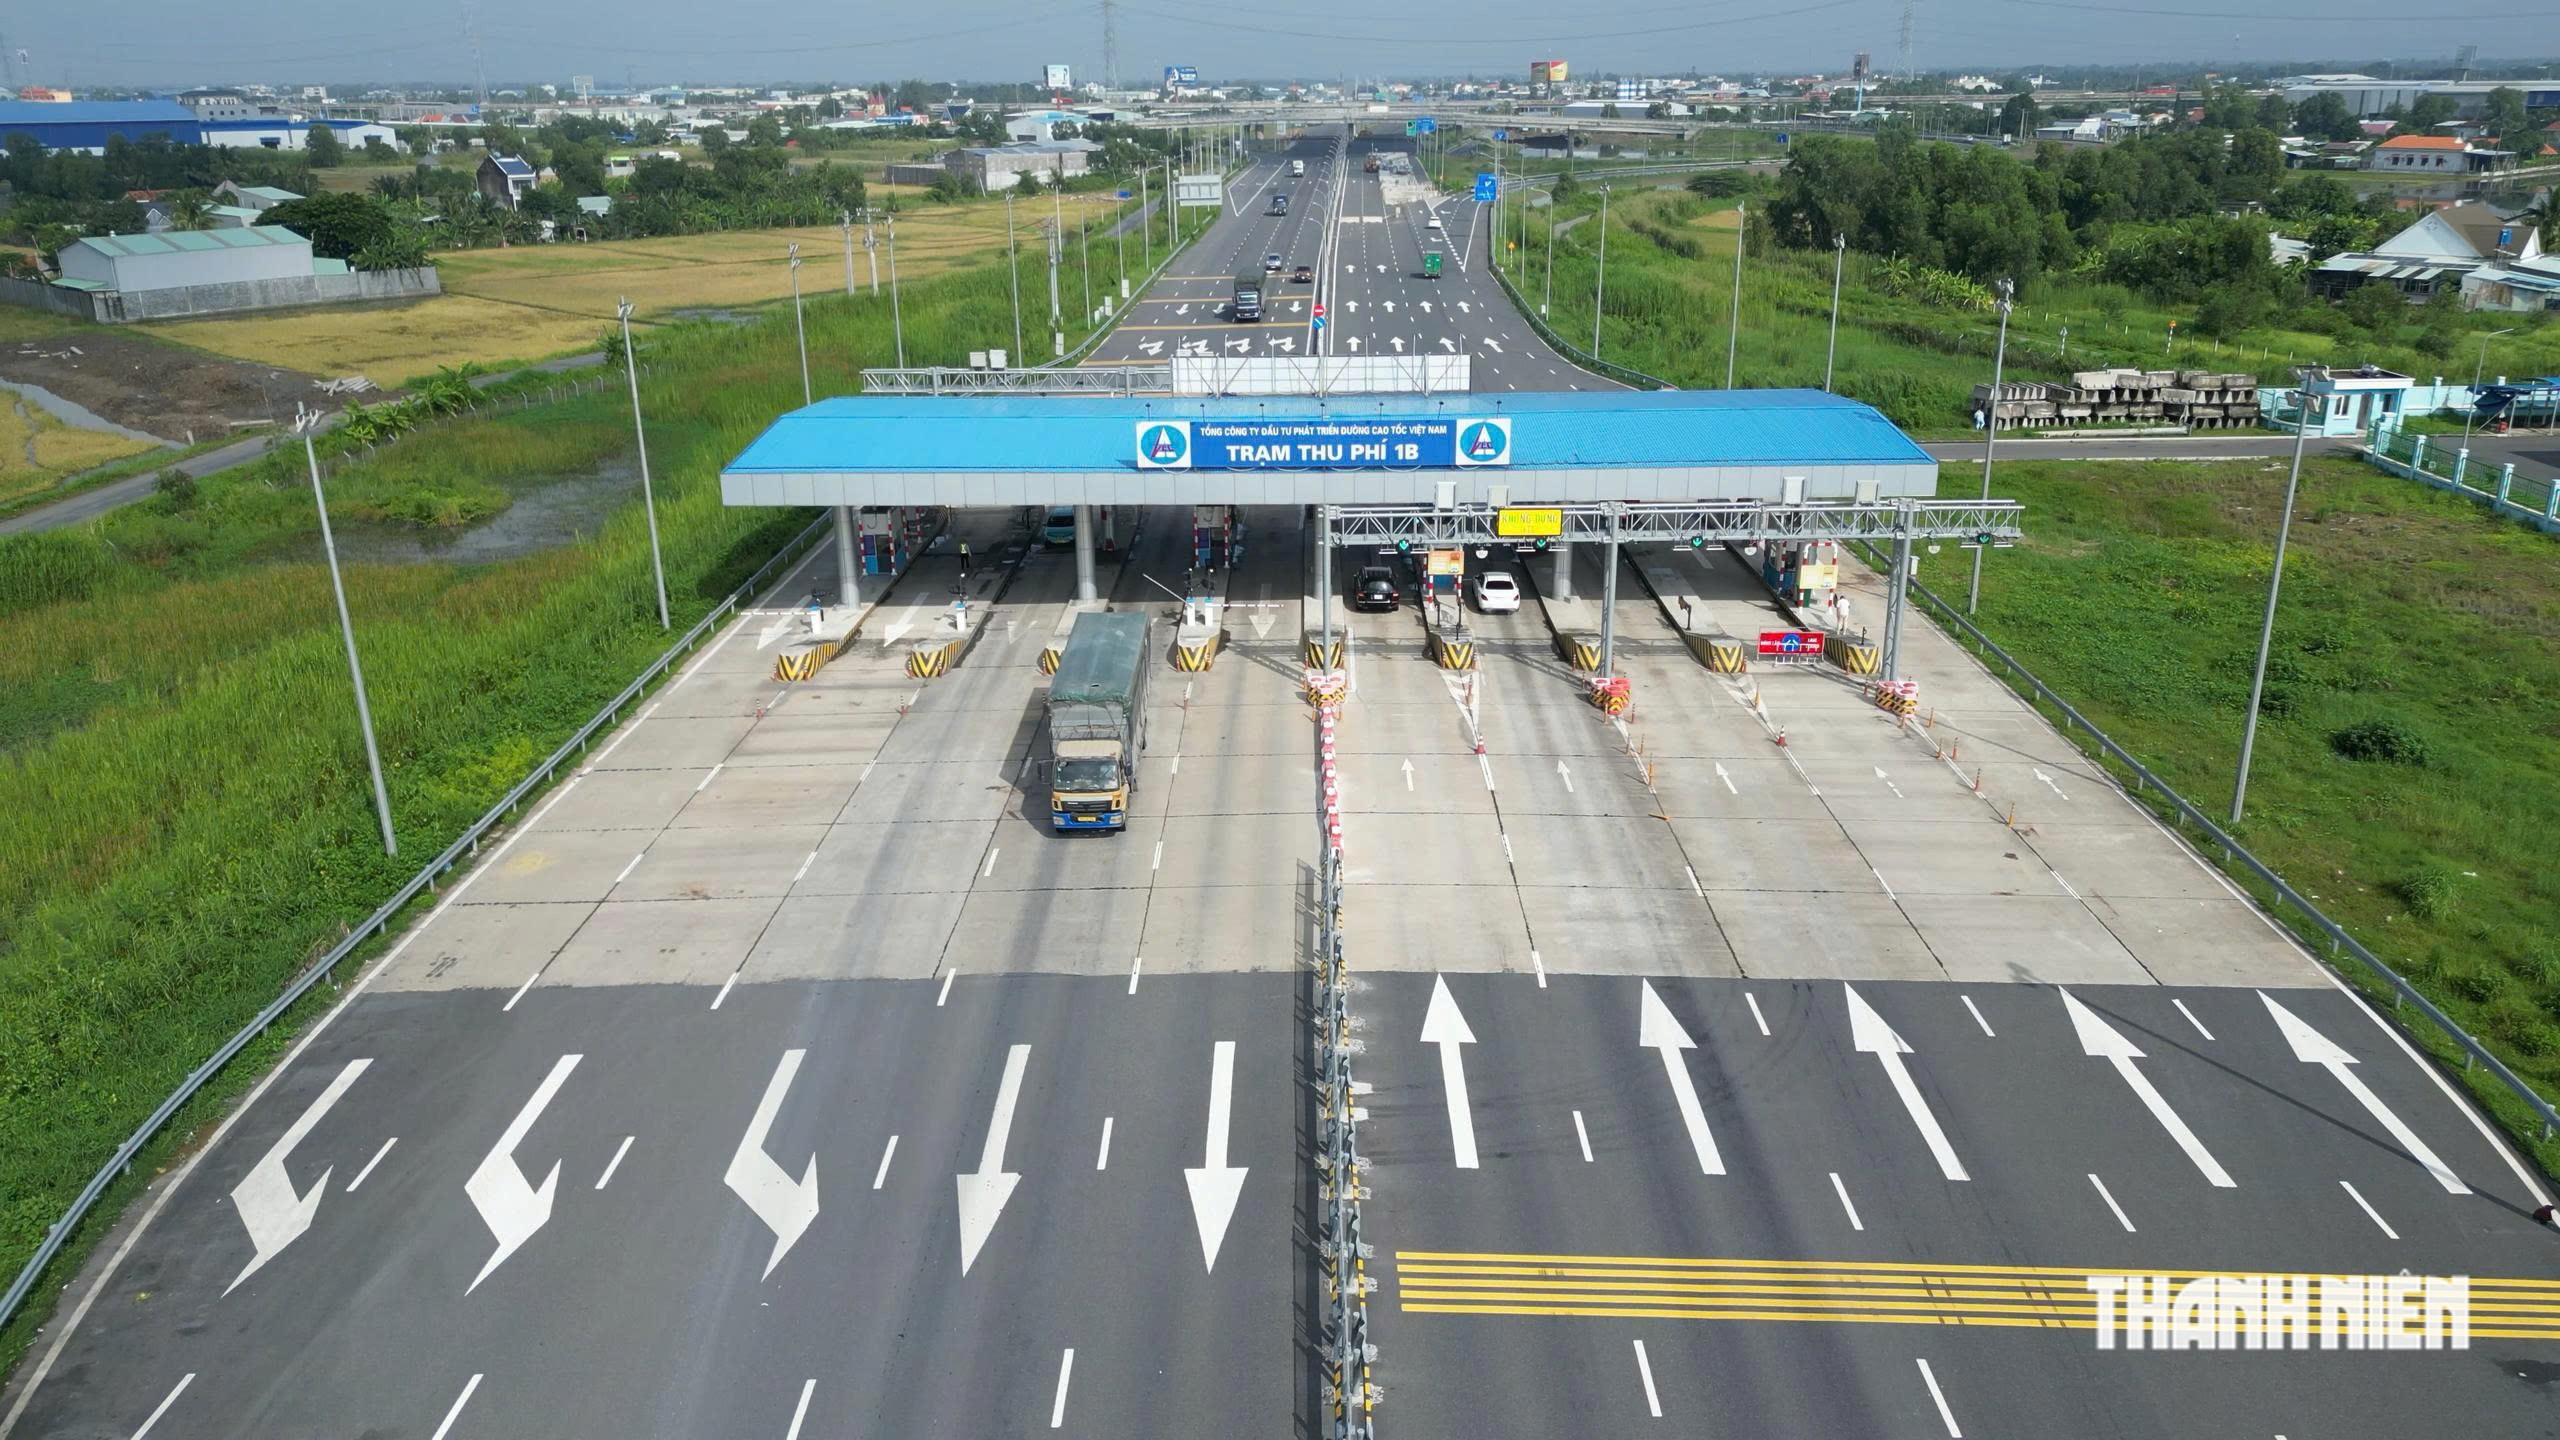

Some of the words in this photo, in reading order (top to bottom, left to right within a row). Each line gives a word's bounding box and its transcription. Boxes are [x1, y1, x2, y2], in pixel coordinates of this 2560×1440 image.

[1200, 423, 1223, 436] TỔNG
[1224, 425, 1248, 436] CÔNG
[1249, 427, 1260, 436] TY
[1280, 426, 1292, 436] TƯ
[1293, 425, 1315, 436] PHÁT
[1371, 426, 1389, 435] CAO
[1391, 423, 1408, 435] TỐC
[1409, 423, 1427, 437] VIỆT
[1428, 425, 1448, 434] NAM
[1225, 444, 1291, 466] TRẠM
[1297, 444, 1343, 461] THU
[1351, 438, 1388, 461] PHÍ
[1394, 443, 1419, 460] 1B
